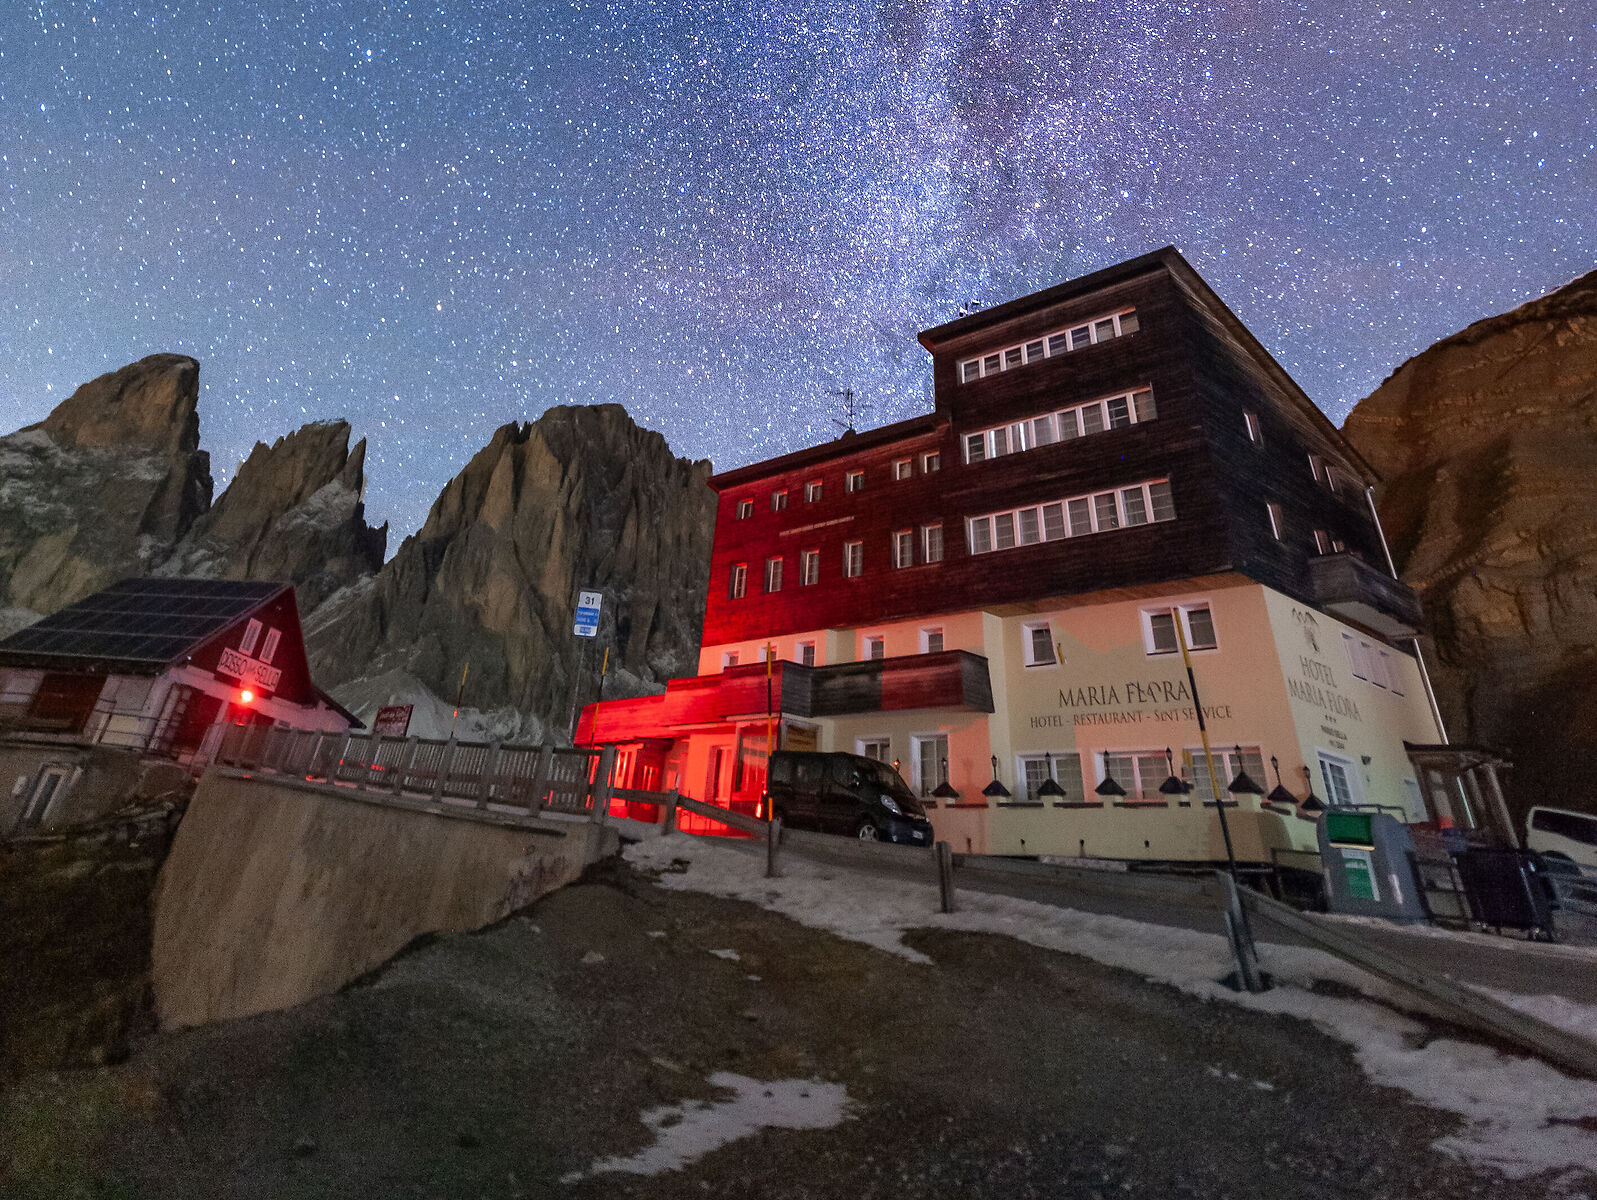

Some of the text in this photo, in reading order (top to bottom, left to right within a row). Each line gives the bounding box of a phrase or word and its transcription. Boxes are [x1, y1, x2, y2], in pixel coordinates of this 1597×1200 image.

[585, 596, 595, 606] 31
[1299, 654, 1337, 688] HOTEL
[1059, 684, 1120, 708] MARIA
[1288, 676, 1362, 722] MARIA FLORA
[1030, 714, 1065, 729] HOTEL
[1073, 709, 1143, 727] RESTAURANT
[1181, 704, 1233, 721] SEVICE
